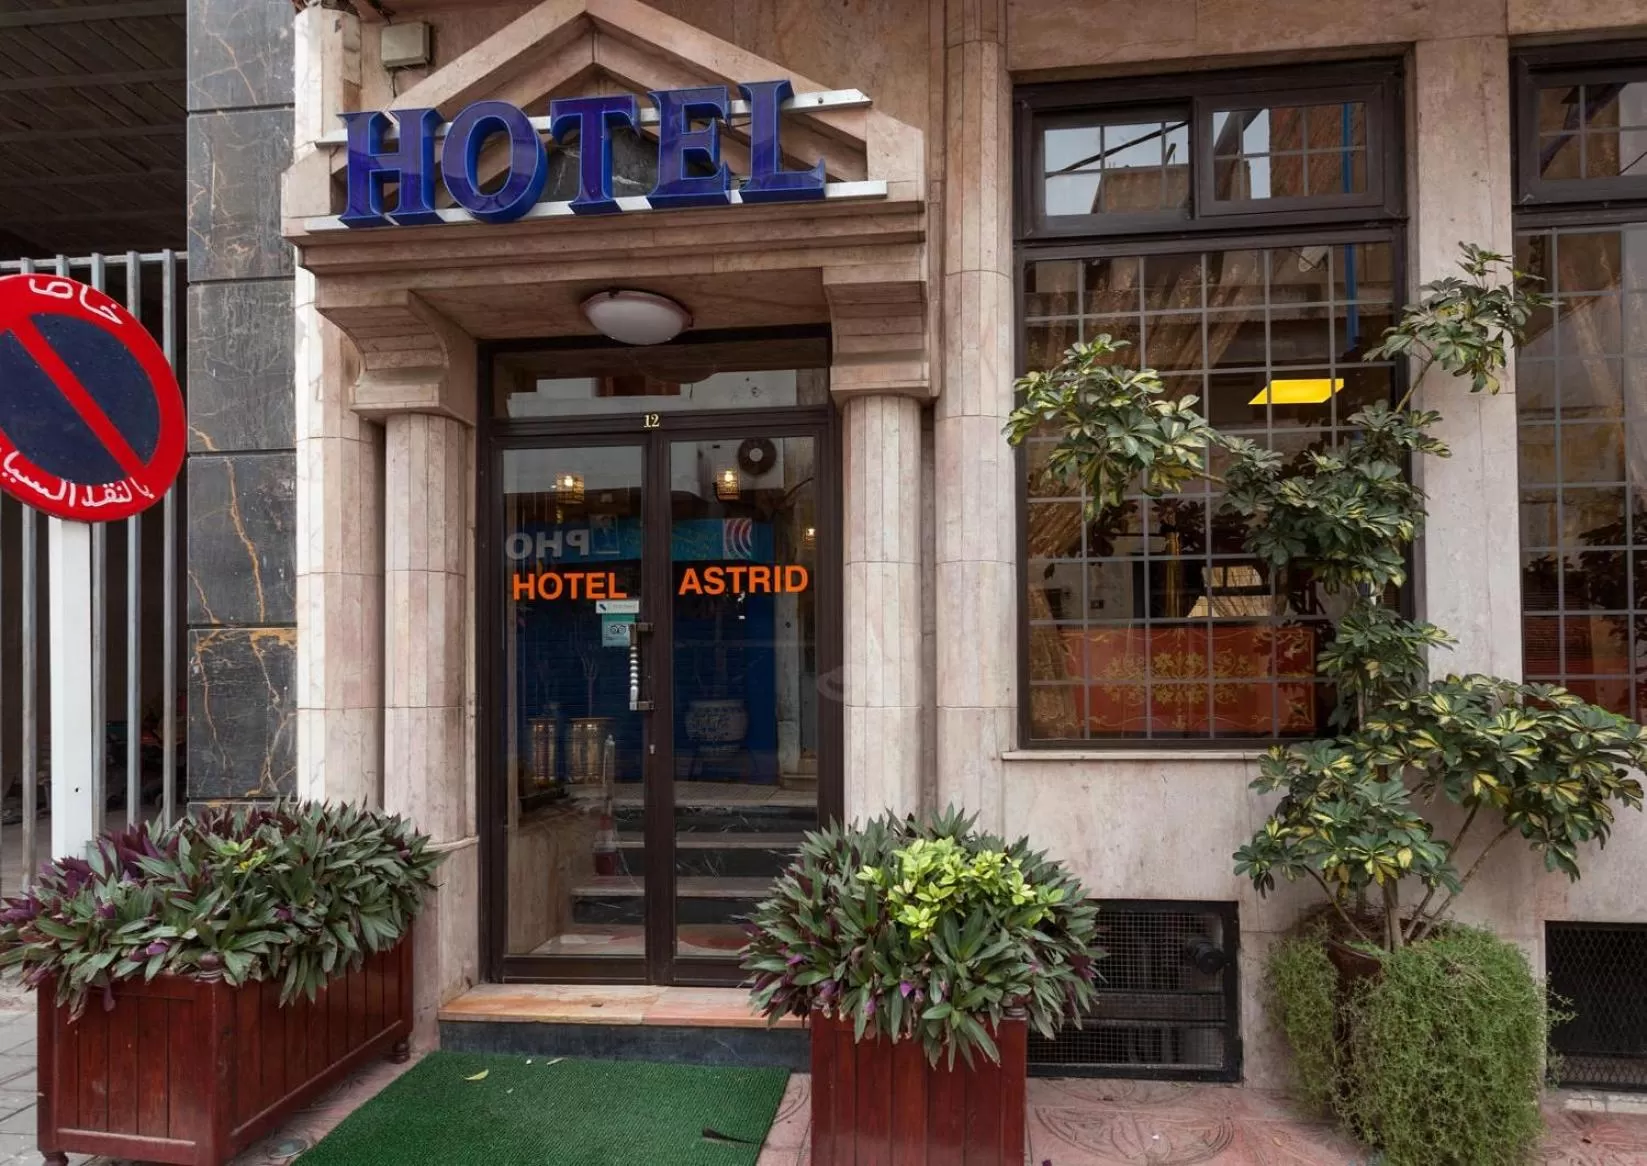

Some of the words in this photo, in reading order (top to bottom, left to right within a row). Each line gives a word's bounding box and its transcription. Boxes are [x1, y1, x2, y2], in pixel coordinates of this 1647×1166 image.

[337, 79, 826, 228] HOTEL
[28, 278, 123, 325] خاص
[643, 413, 660, 428] 12
[512, 572, 628, 600] HOTEL
[678, 565, 809, 596] ASTRID
